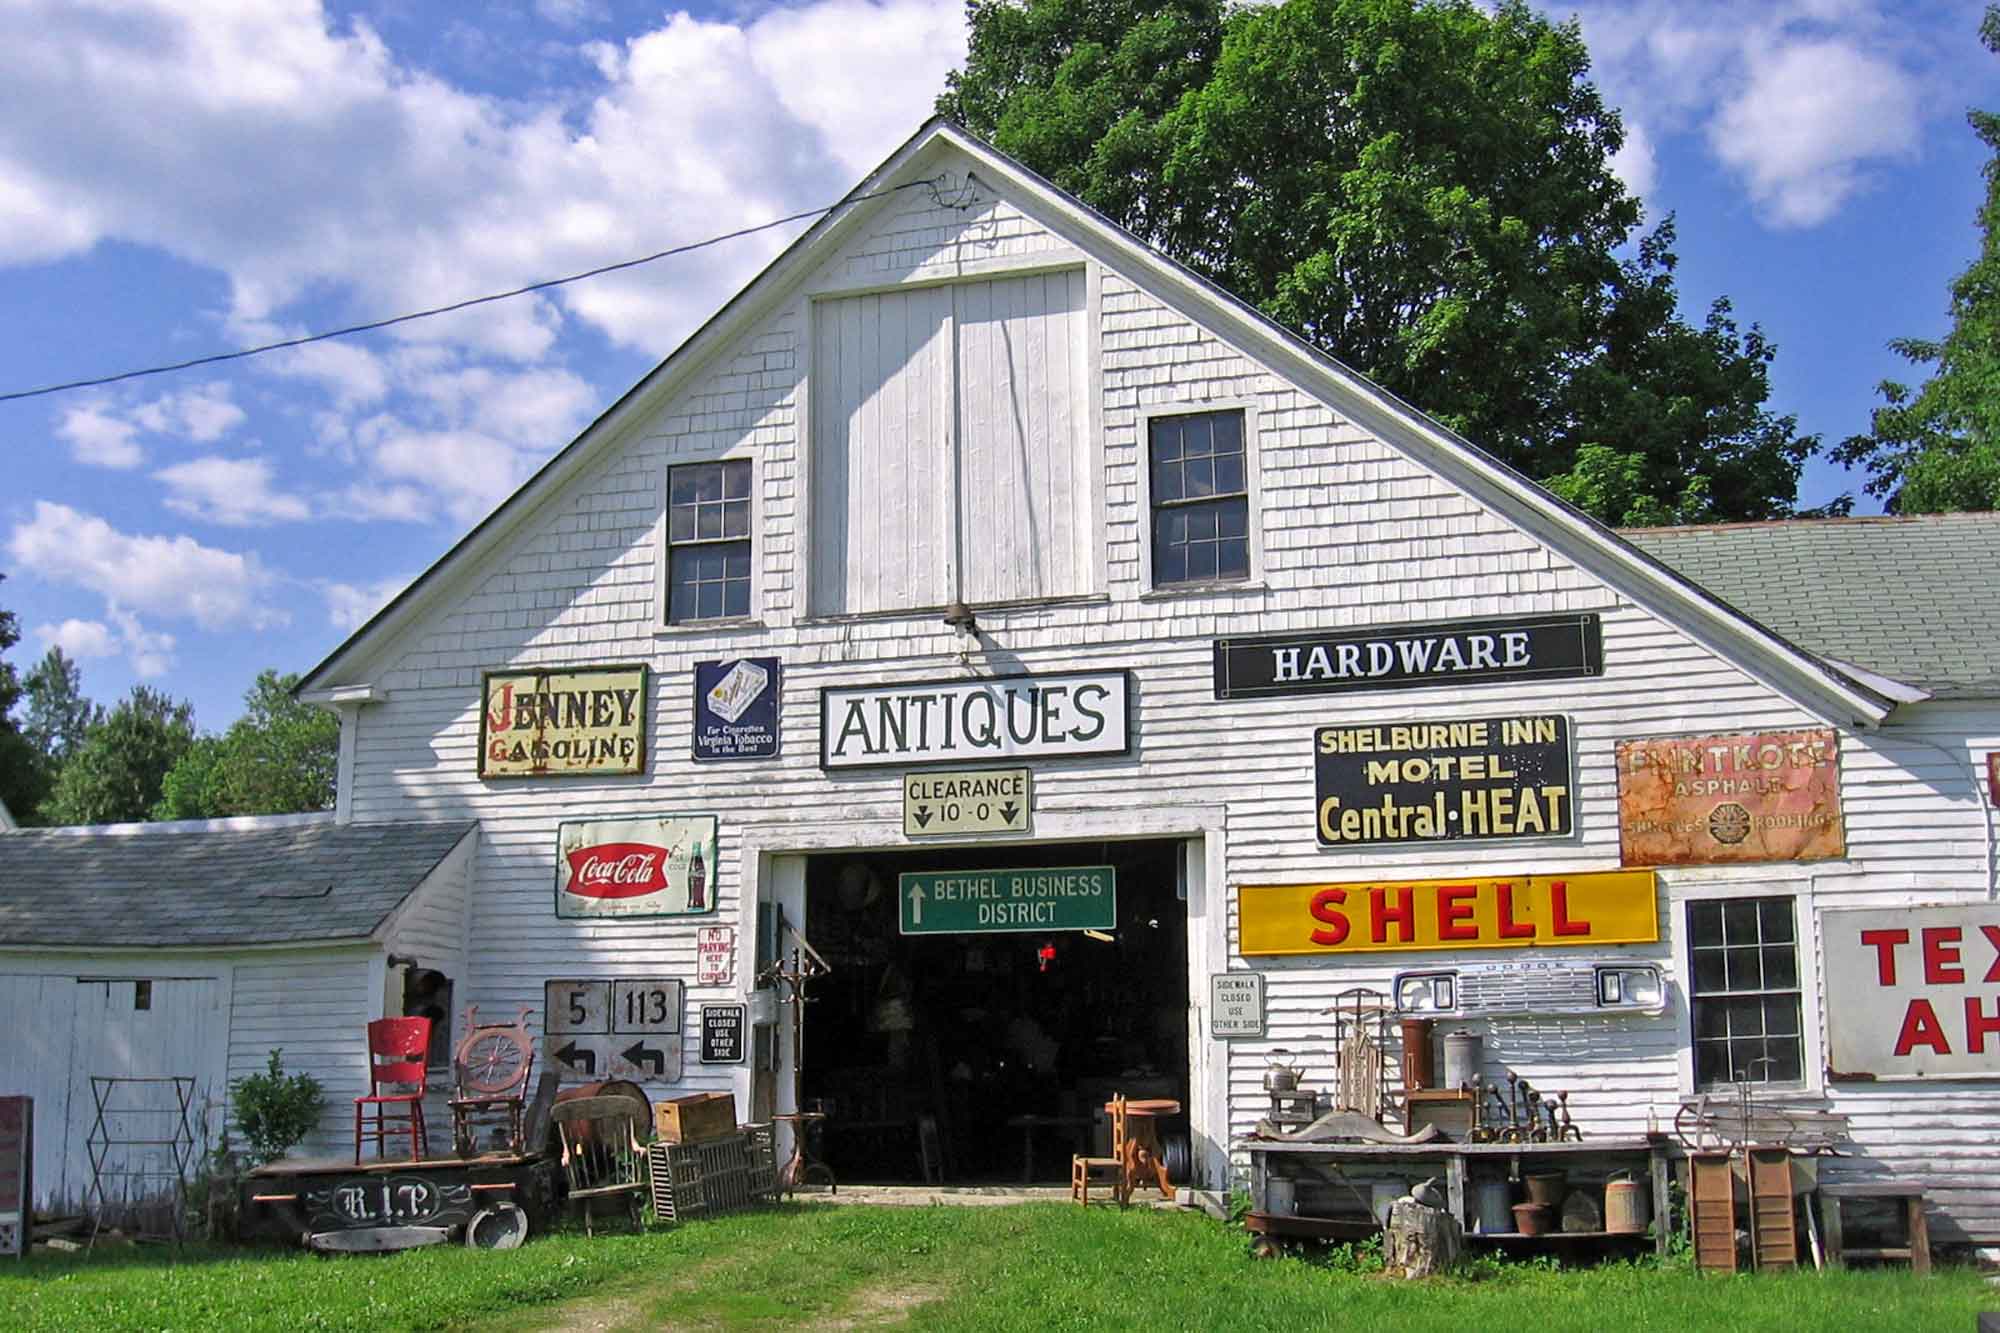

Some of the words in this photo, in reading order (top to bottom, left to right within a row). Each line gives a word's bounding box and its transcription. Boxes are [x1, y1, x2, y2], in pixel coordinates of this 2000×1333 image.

[1272, 632, 1532, 683] HARDWARE
[487, 683, 639, 732] JENNEY
[830, 684, 1111, 757] ANTIQUES
[734, 733, 773, 745] Tobacco
[1320, 722, 1490, 755] SHELBURNE
[1502, 719, 1558, 745] INN
[1367, 754, 1515, 786] MOTEL
[909, 777, 1024, 801] CLEARANCE
[1319, 790, 1446, 842] Central
[1461, 786, 1568, 834] HEAT
[933, 878, 1001, 901] BETHEL
[1010, 875, 1103, 898] BUSINESS
[978, 901, 1057, 925] DISTRICT
[1309, 880, 1591, 946] SHELL
[707, 928, 722, 941] NO
[570, 992, 586, 1024] 5
[627, 991, 667, 1024] 113
[705, 1008, 740, 1018] SIDEWALK
[1228, 1006, 1244, 1016] USE
[708, 1018, 736, 1029] CLOSED
[714, 1028, 729, 1039] USE
[710, 1038, 734, 1049] OTHER
[713, 1048, 731, 1058] SIDE
